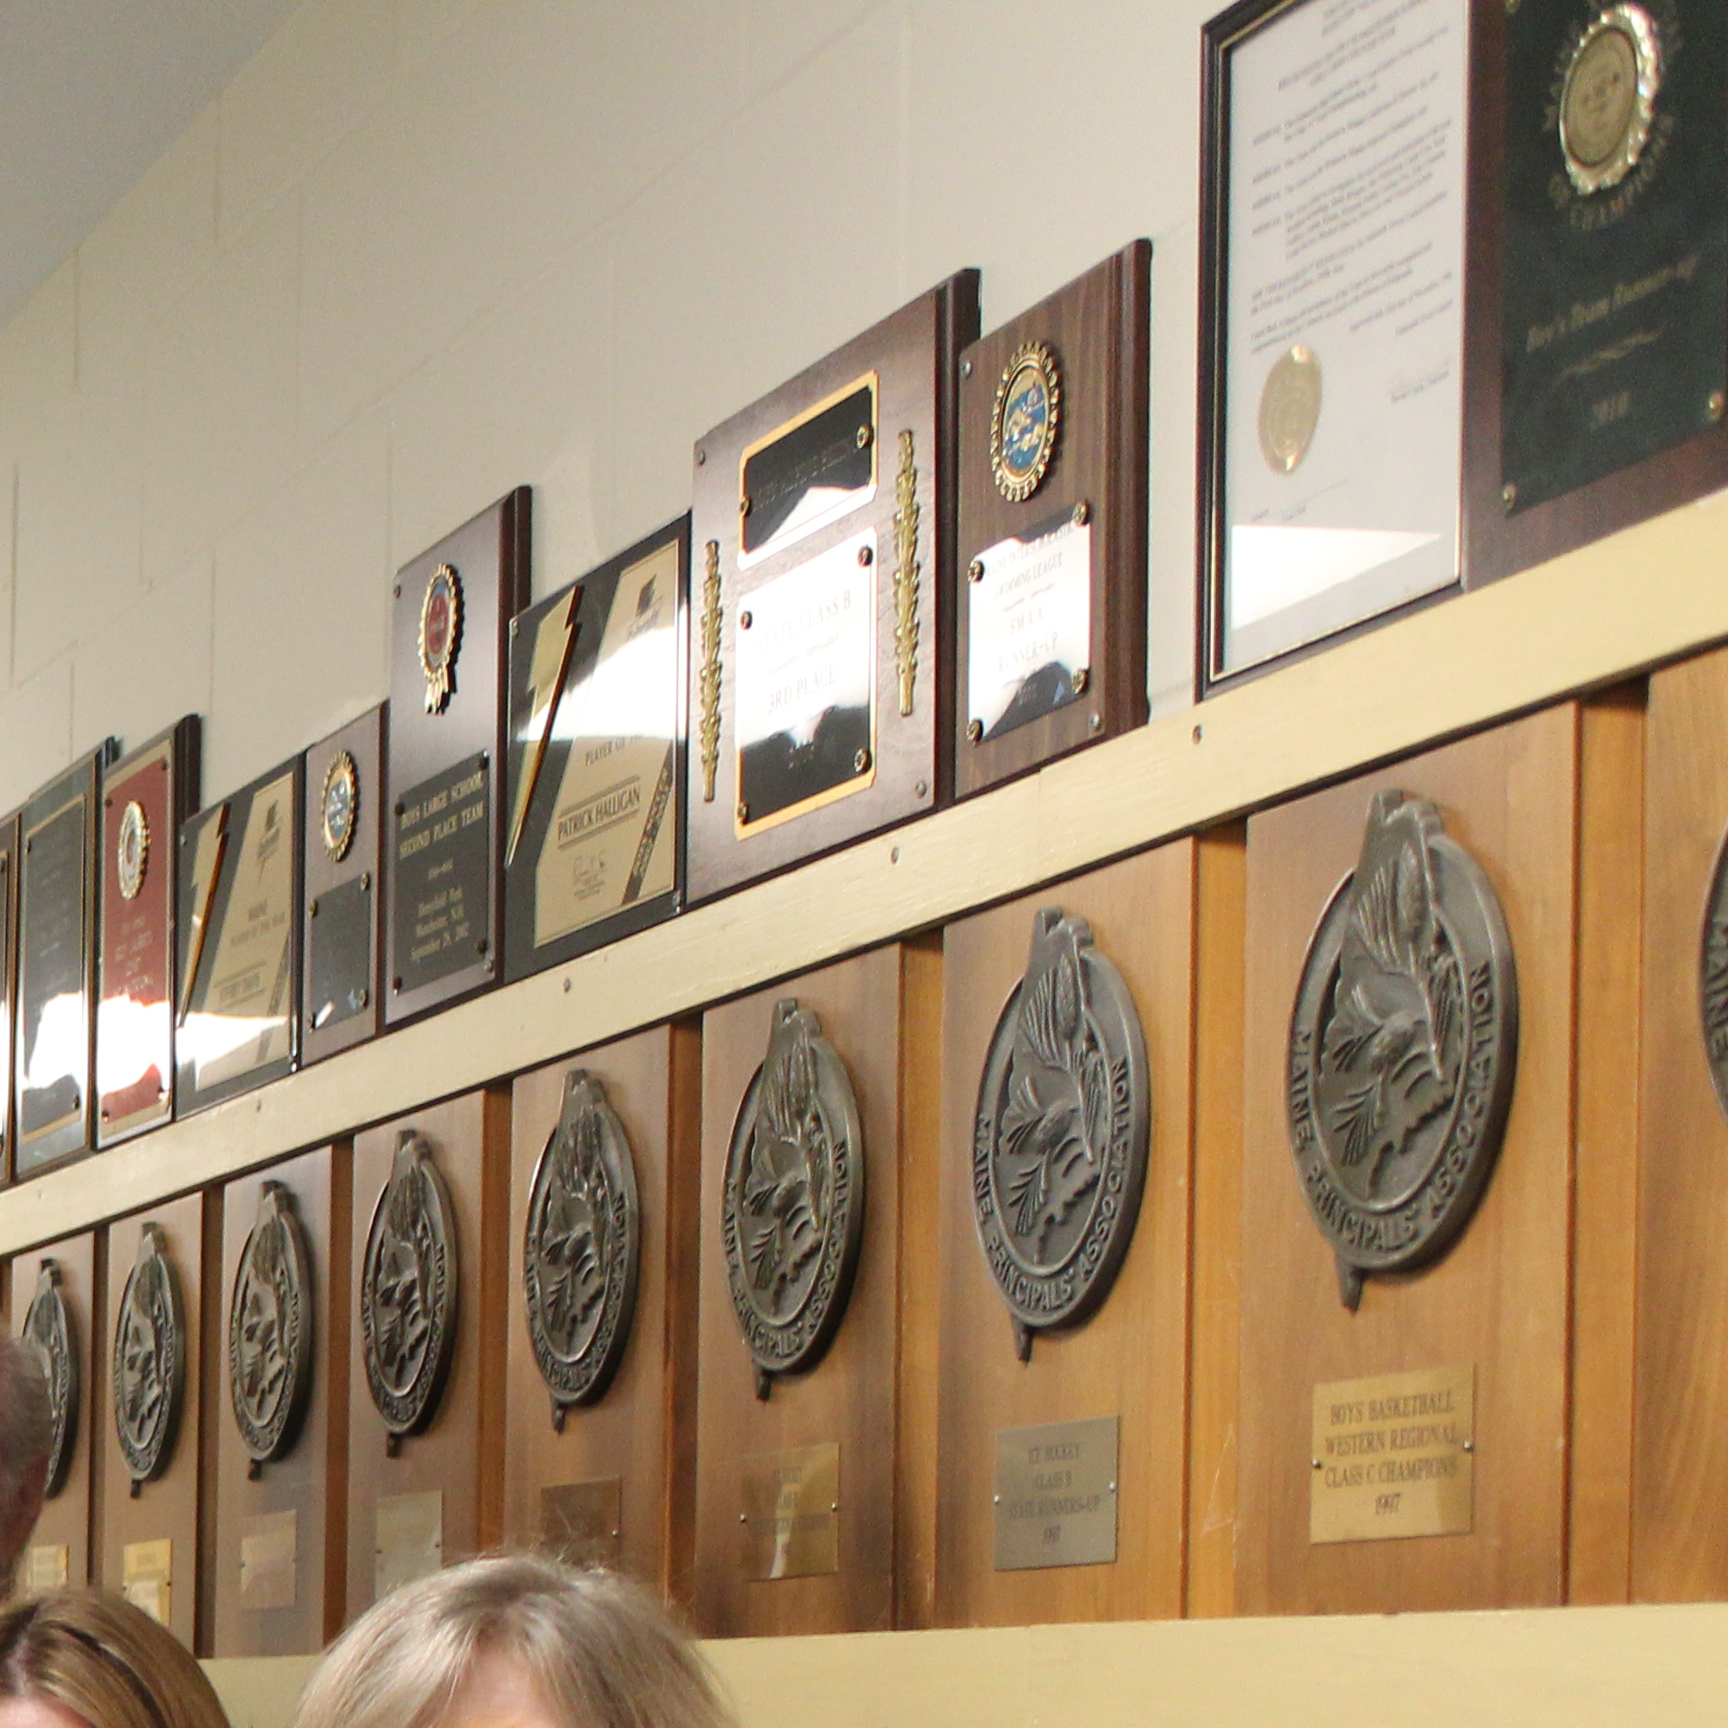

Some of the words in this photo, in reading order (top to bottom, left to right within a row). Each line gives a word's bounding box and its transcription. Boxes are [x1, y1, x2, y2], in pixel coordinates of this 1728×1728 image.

[799, 596, 840, 632] CLASS
[843, 588, 853, 612] B
[768, 682, 792, 716] 3RD
[796, 663, 837, 701] PLACE
[422, 789, 449, 821] LARGE
[451, 771, 484, 803] SCHOOL
[557, 811, 595, 841] PATRICK
[594, 784, 642, 826] HALLIGAN
[399, 828, 431, 860] SECOND
[433, 814, 458, 842] PLACE
[461, 800, 484, 828] TEAM
[1290, 1028, 1315, 1150] MAINE
[975, 1114, 994, 1225] MAINE
[1078, 1055, 1130, 1282] ASSOCIATION
[1368, 1389, 1455, 1422] BASKETBALL
[1324, 1431, 1386, 1456] WESTERN
[1389, 1421, 1460, 1450] REGIONAL
[1325, 1462, 1363, 1488] CLASS
[1378, 1454, 1458, 1483] CHAMPIONS
